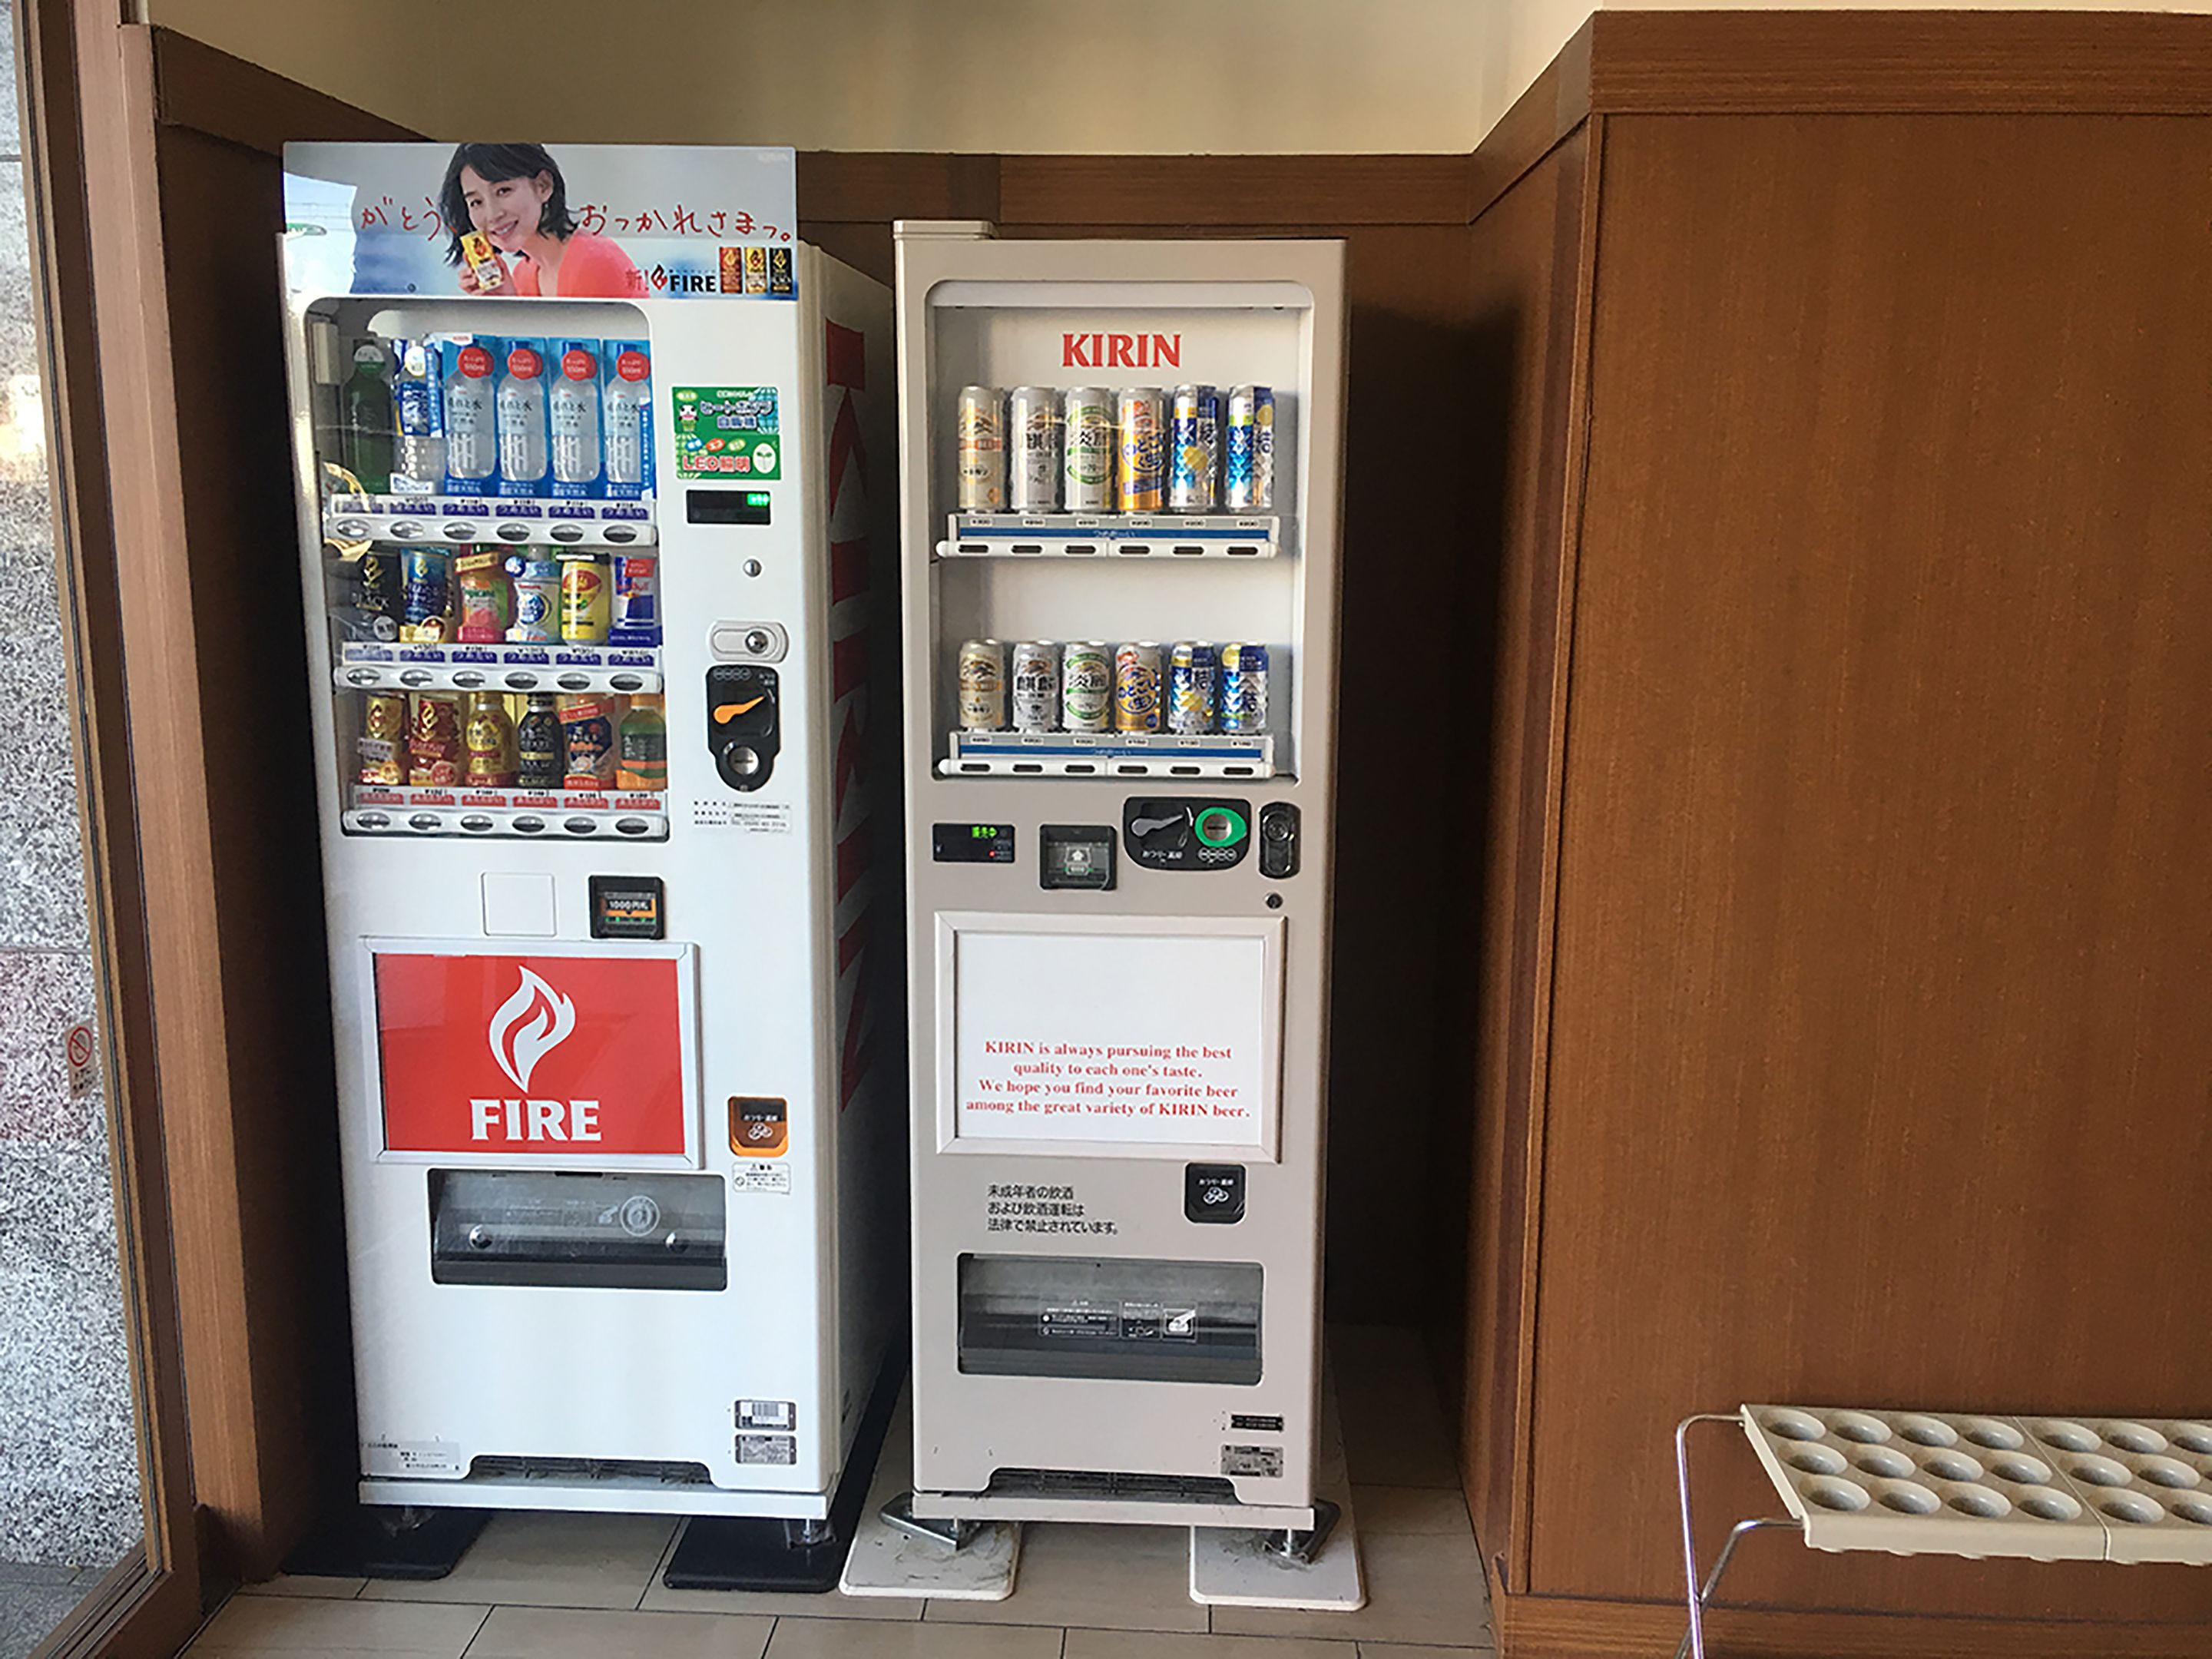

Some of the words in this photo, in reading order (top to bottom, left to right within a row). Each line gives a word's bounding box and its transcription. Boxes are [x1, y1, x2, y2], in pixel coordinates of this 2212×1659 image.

[670, 275, 717, 293] FIRE
[1061, 333, 1181, 369] KIRIN
[985, 1040, 1035, 1055] KIRIN
[1039, 1042, 1051, 1055] is
[1055, 1043, 1103, 1059] always
[1107, 1045, 1171, 1060] pursuing
[1175, 1045, 1198, 1058] the
[1202, 1045, 1232, 1059] best
[1013, 1062, 1063, 1078] quality
[1068, 1065, 1082, 1076] to
[1085, 1063, 1118, 1076] each
[1121, 1064, 1158, 1077] one's
[1163, 1065, 1203, 1078] taste.
[979, 1079, 1002, 1092] We
[1006, 1081, 1041, 1097] hope
[1045, 1084, 1071, 1098] you
[1075, 1082, 1104, 1095] find
[1108, 1084, 1141, 1098] your
[1145, 1084, 1202, 1098] favorite
[1206, 1085, 1239, 1098] beer
[966, 1101, 1015, 1114] among
[1018, 1101, 1040, 1112] the
[1044, 1101, 1081, 1115] great
[1086, 1101, 1134, 1117] variety
[1139, 1103, 1155, 1115] of
[1158, 1103, 1208, 1117] KIRIN
[1212, 1104, 1251, 1118] beer.
[469, 1098, 601, 1142] FIRE
[987, 1185, 1074, 1200] 未成年者の飲酒
[987, 1203, 1084, 1217] および飲酒運転は
[987, 1219, 1118, 1235] 法律で禁止されています。
